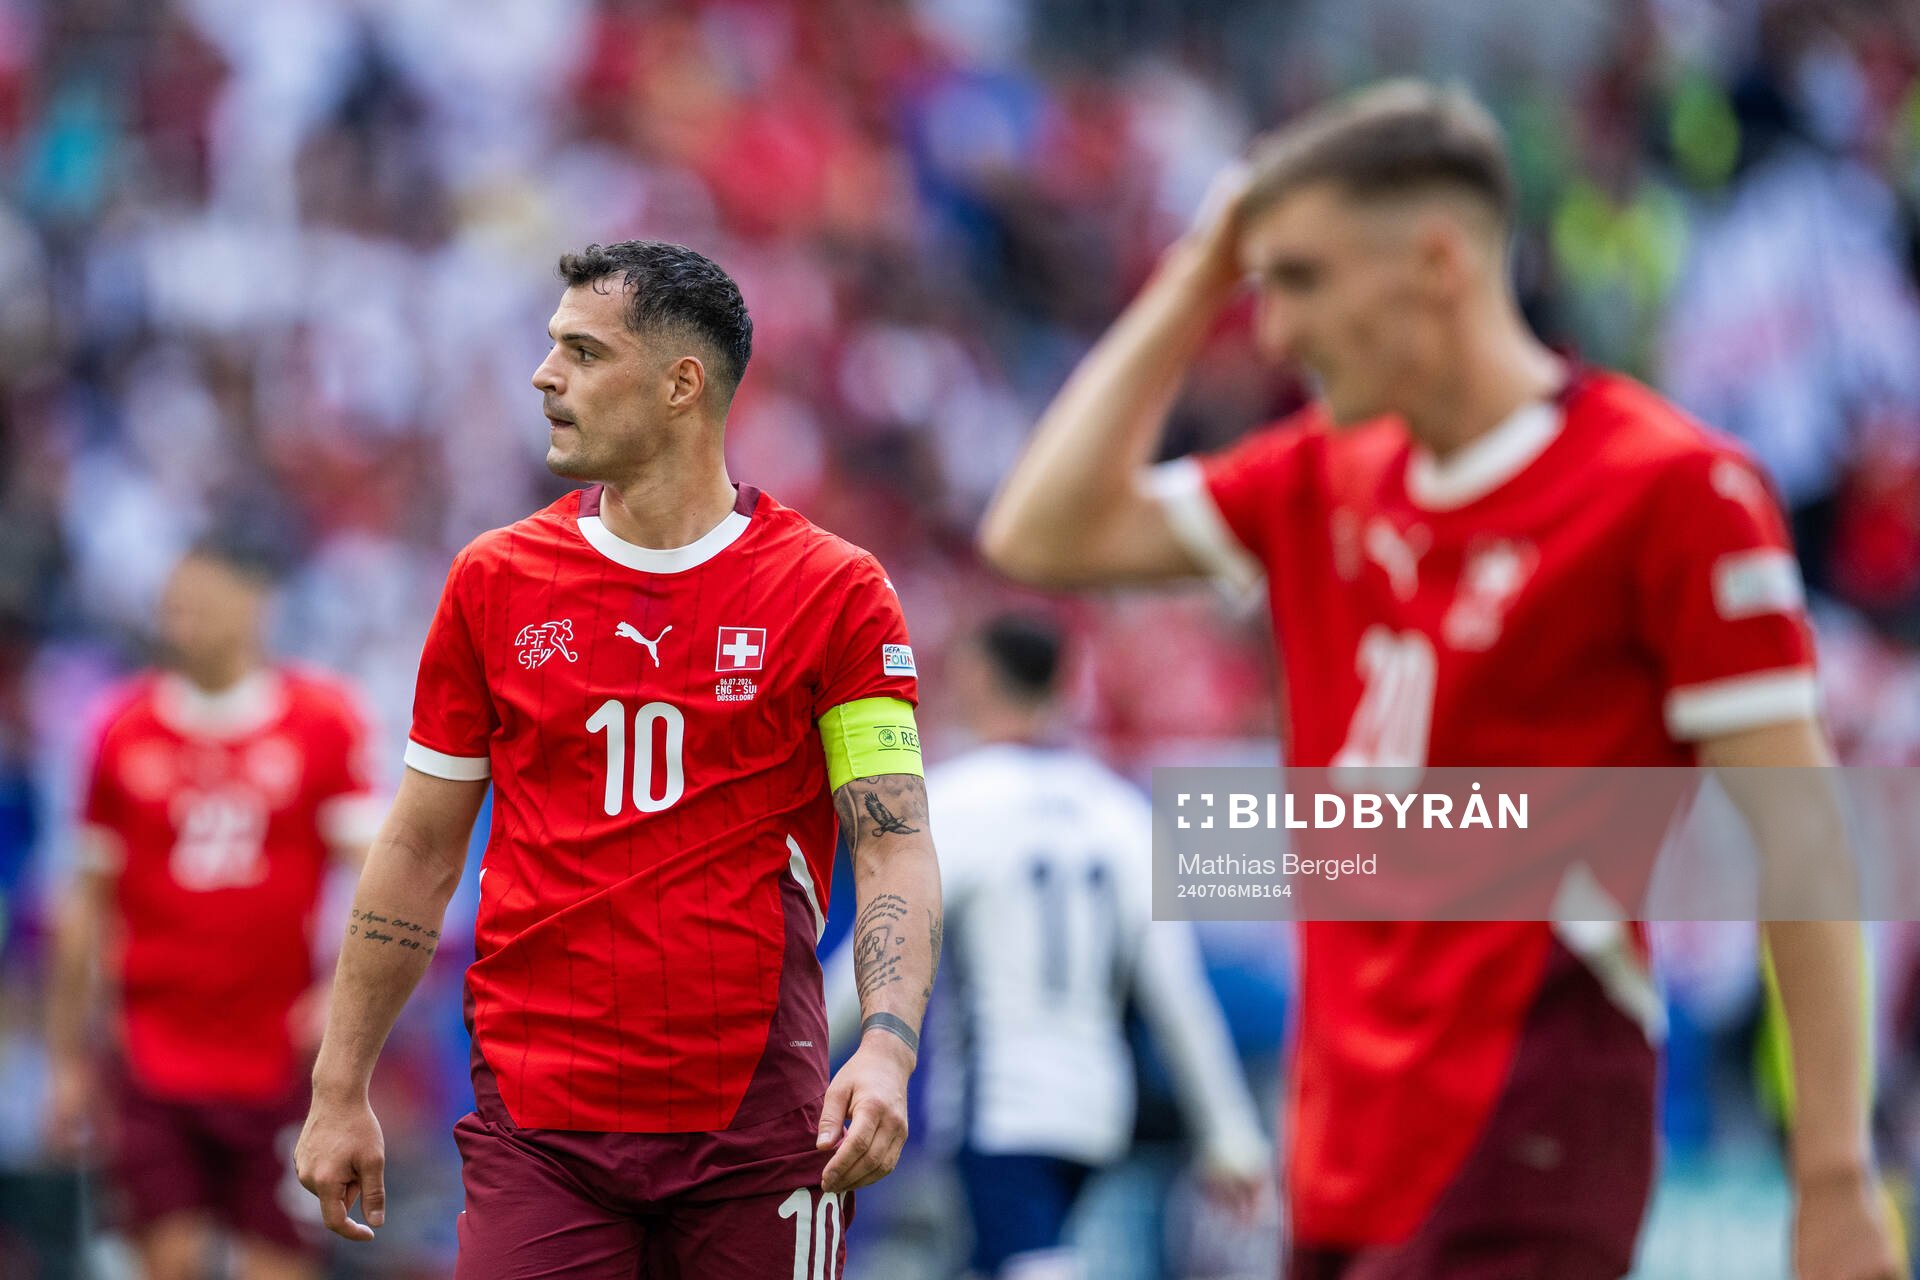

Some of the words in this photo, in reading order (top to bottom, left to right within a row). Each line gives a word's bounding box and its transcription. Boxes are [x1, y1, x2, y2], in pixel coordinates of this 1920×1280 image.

[720, 678, 752, 686] 06.07.2024
[715, 684, 732, 695] ENG
[743, 684, 757, 694] SUI
[716, 693, 755, 701] DÜSSELDORF
[585, 699, 685, 816] 10
[778, 1187, 842, 1280] 10
